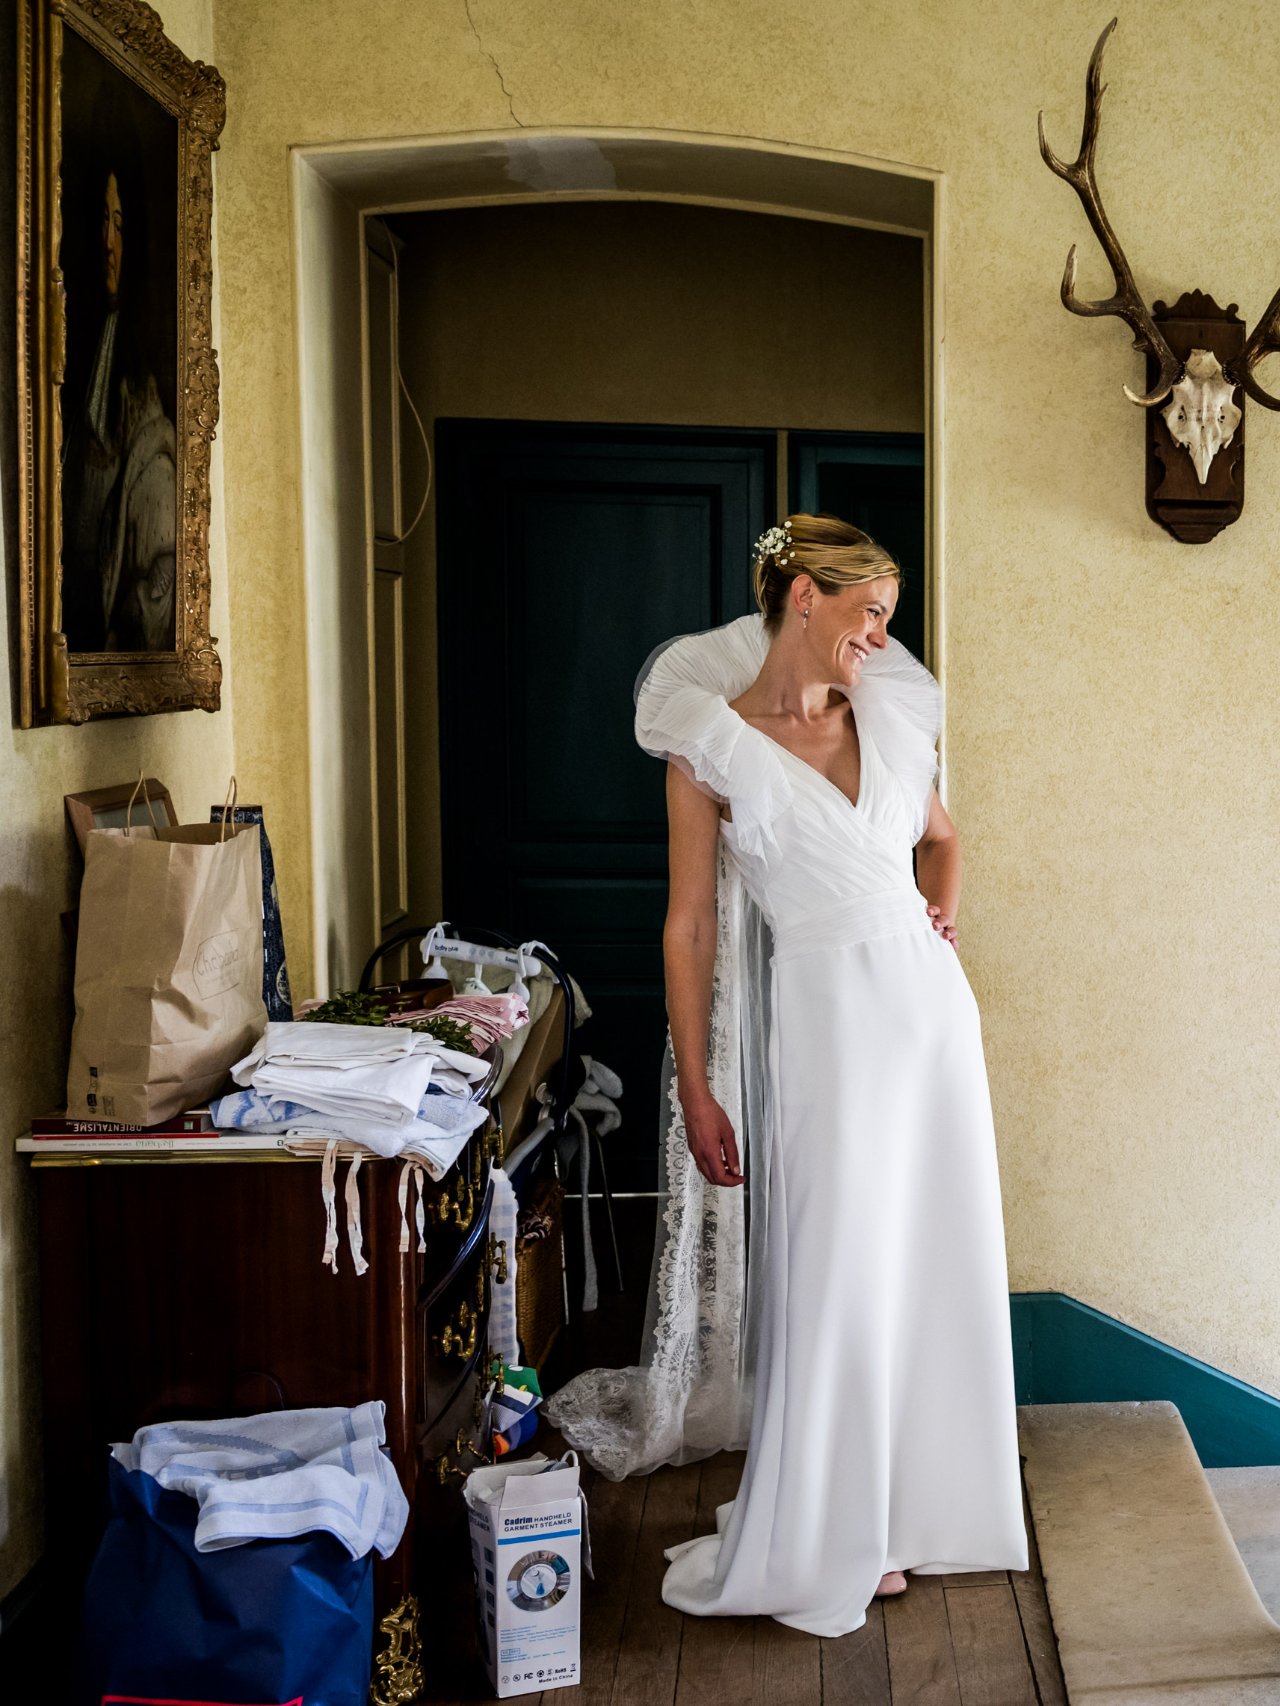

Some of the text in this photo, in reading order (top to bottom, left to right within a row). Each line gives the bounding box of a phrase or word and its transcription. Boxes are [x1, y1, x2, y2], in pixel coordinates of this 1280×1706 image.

[73, 1123, 142, 1132] ORIENTALISME
[504, 1512, 572, 1526] Cadrim HANDHELD
[504, 1519, 573, 1532] GARMENT STEAMER
